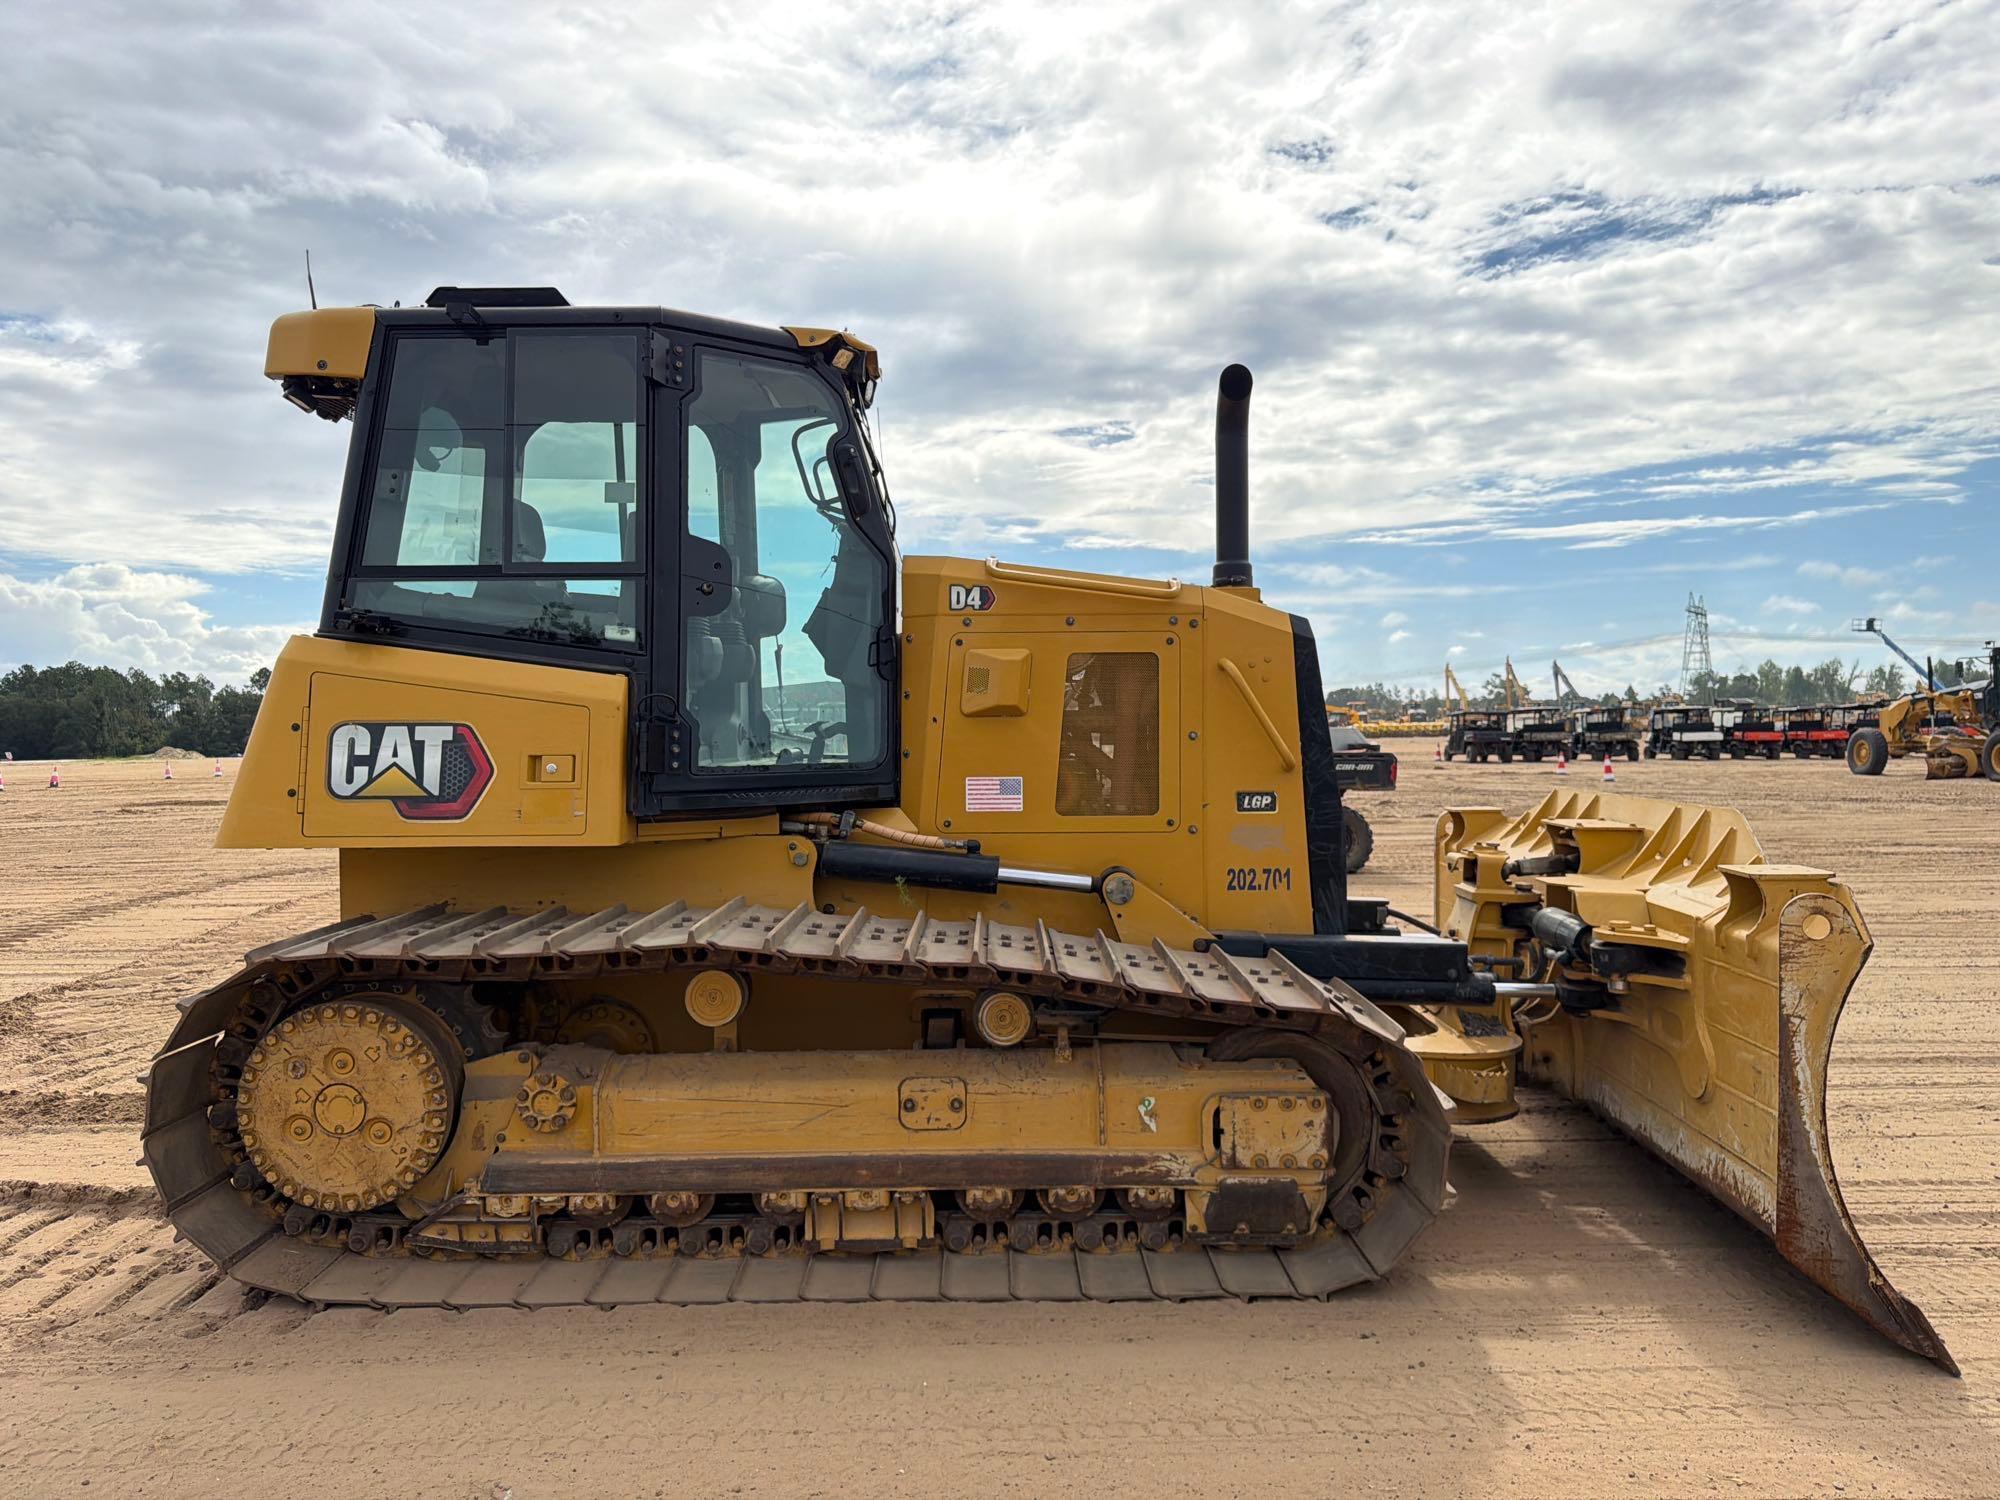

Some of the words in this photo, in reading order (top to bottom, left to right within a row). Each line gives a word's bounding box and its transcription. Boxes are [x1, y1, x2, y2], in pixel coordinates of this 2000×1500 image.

[951, 585, 981, 610] D4
[331, 724, 454, 797] CAT
[1243, 795, 1272, 809] LGP
[1226, 867, 1291, 891] 202.701
